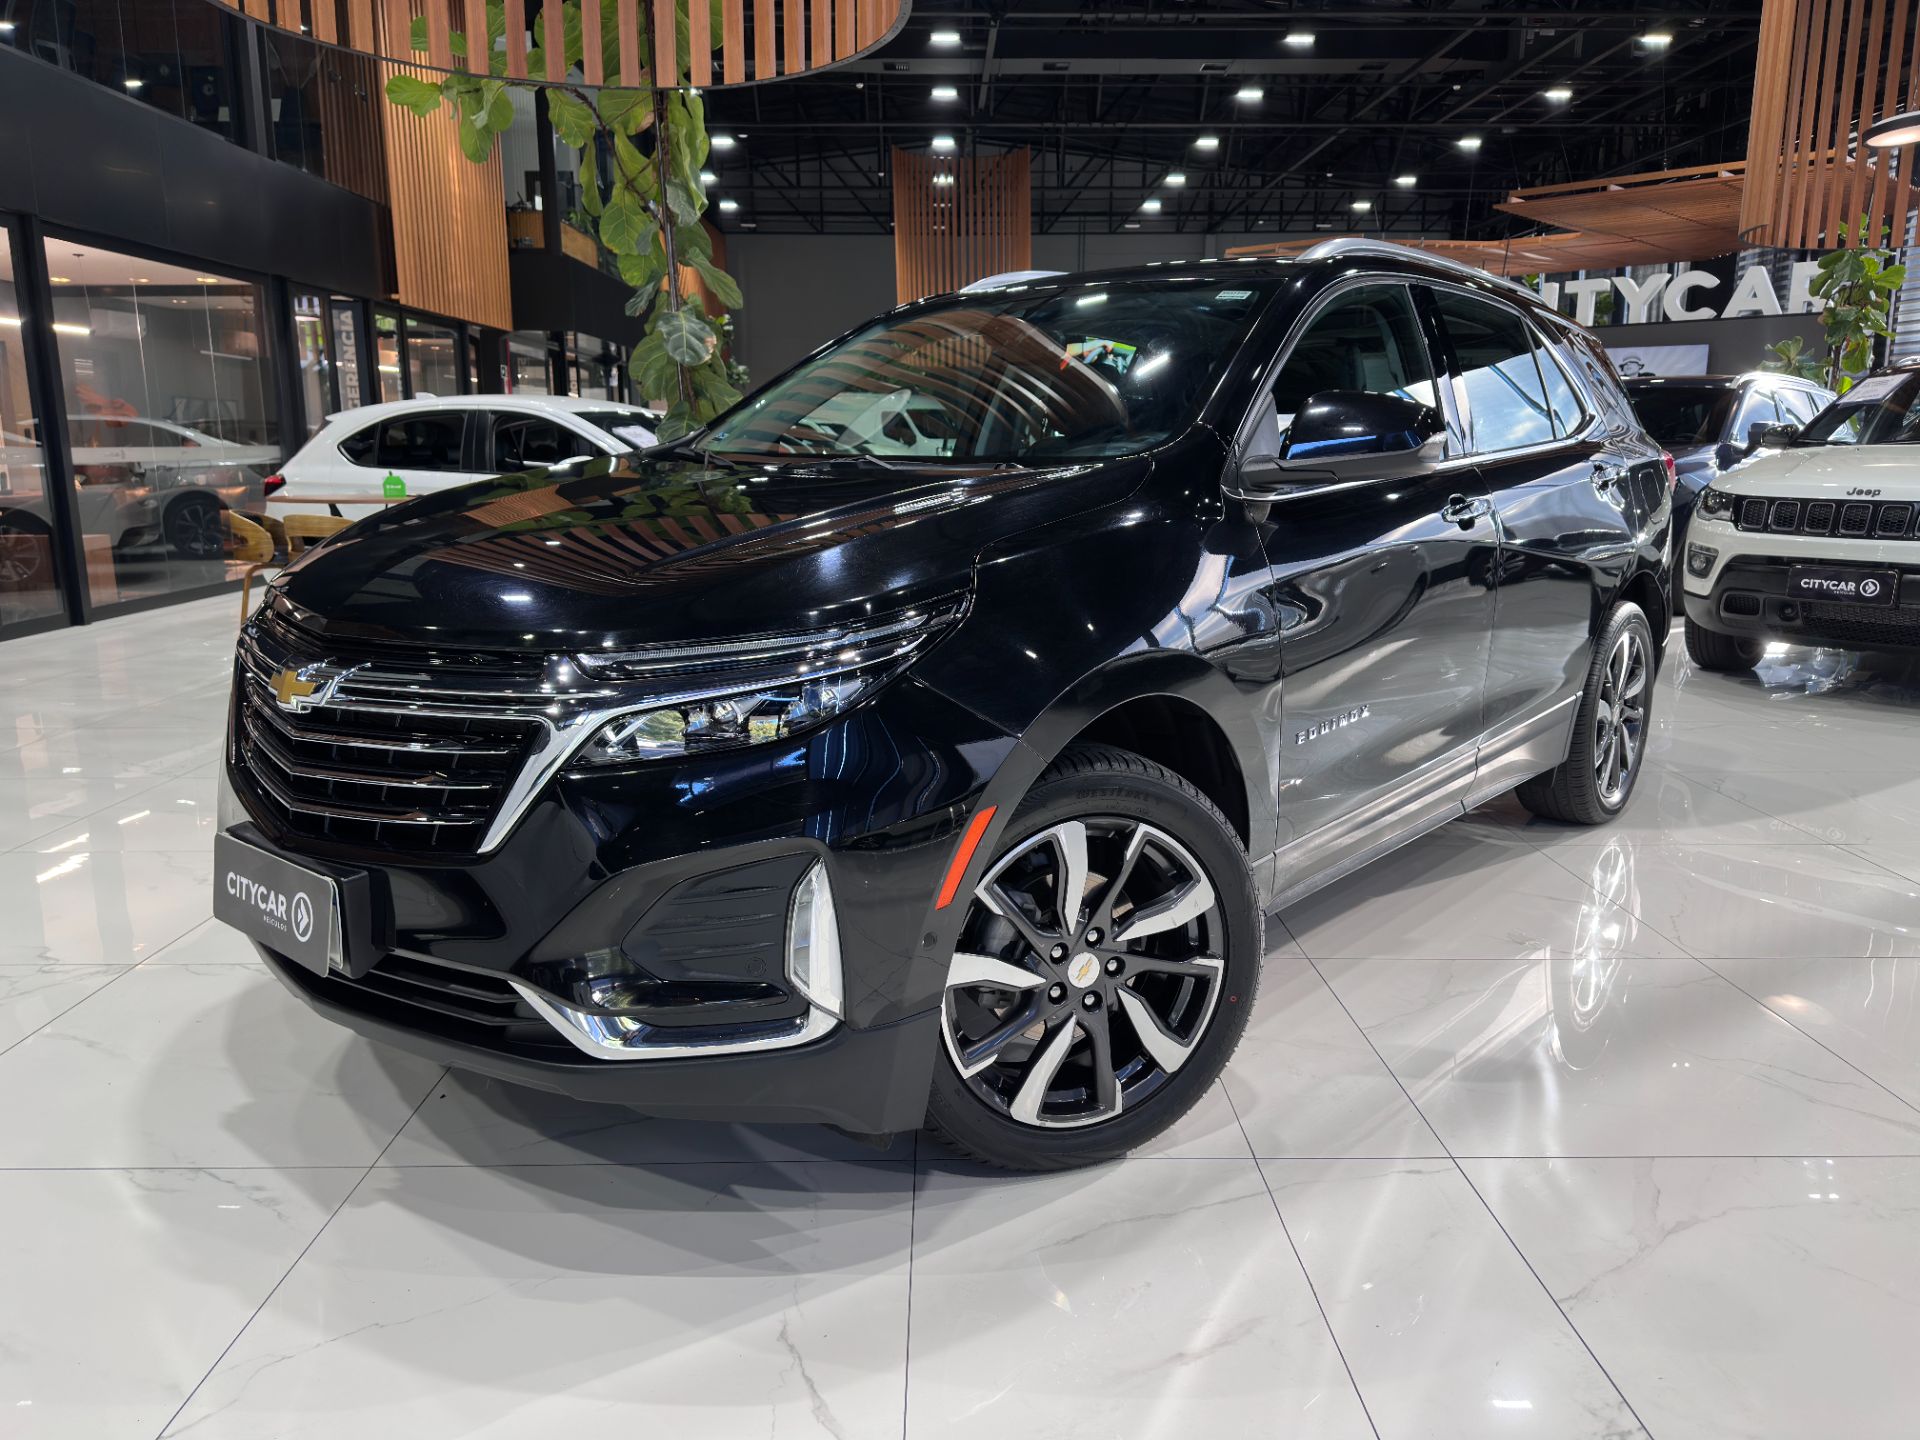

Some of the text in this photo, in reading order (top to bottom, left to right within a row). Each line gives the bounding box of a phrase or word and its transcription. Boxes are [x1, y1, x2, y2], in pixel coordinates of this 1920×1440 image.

[1542, 260, 1832, 327] ITYCAR
[1846, 487, 1882, 498] Jeep
[1800, 578, 1856, 592] CITYCAR
[1295, 704, 1370, 745] EQUINOX
[226, 871, 287, 921] CITYCAR
